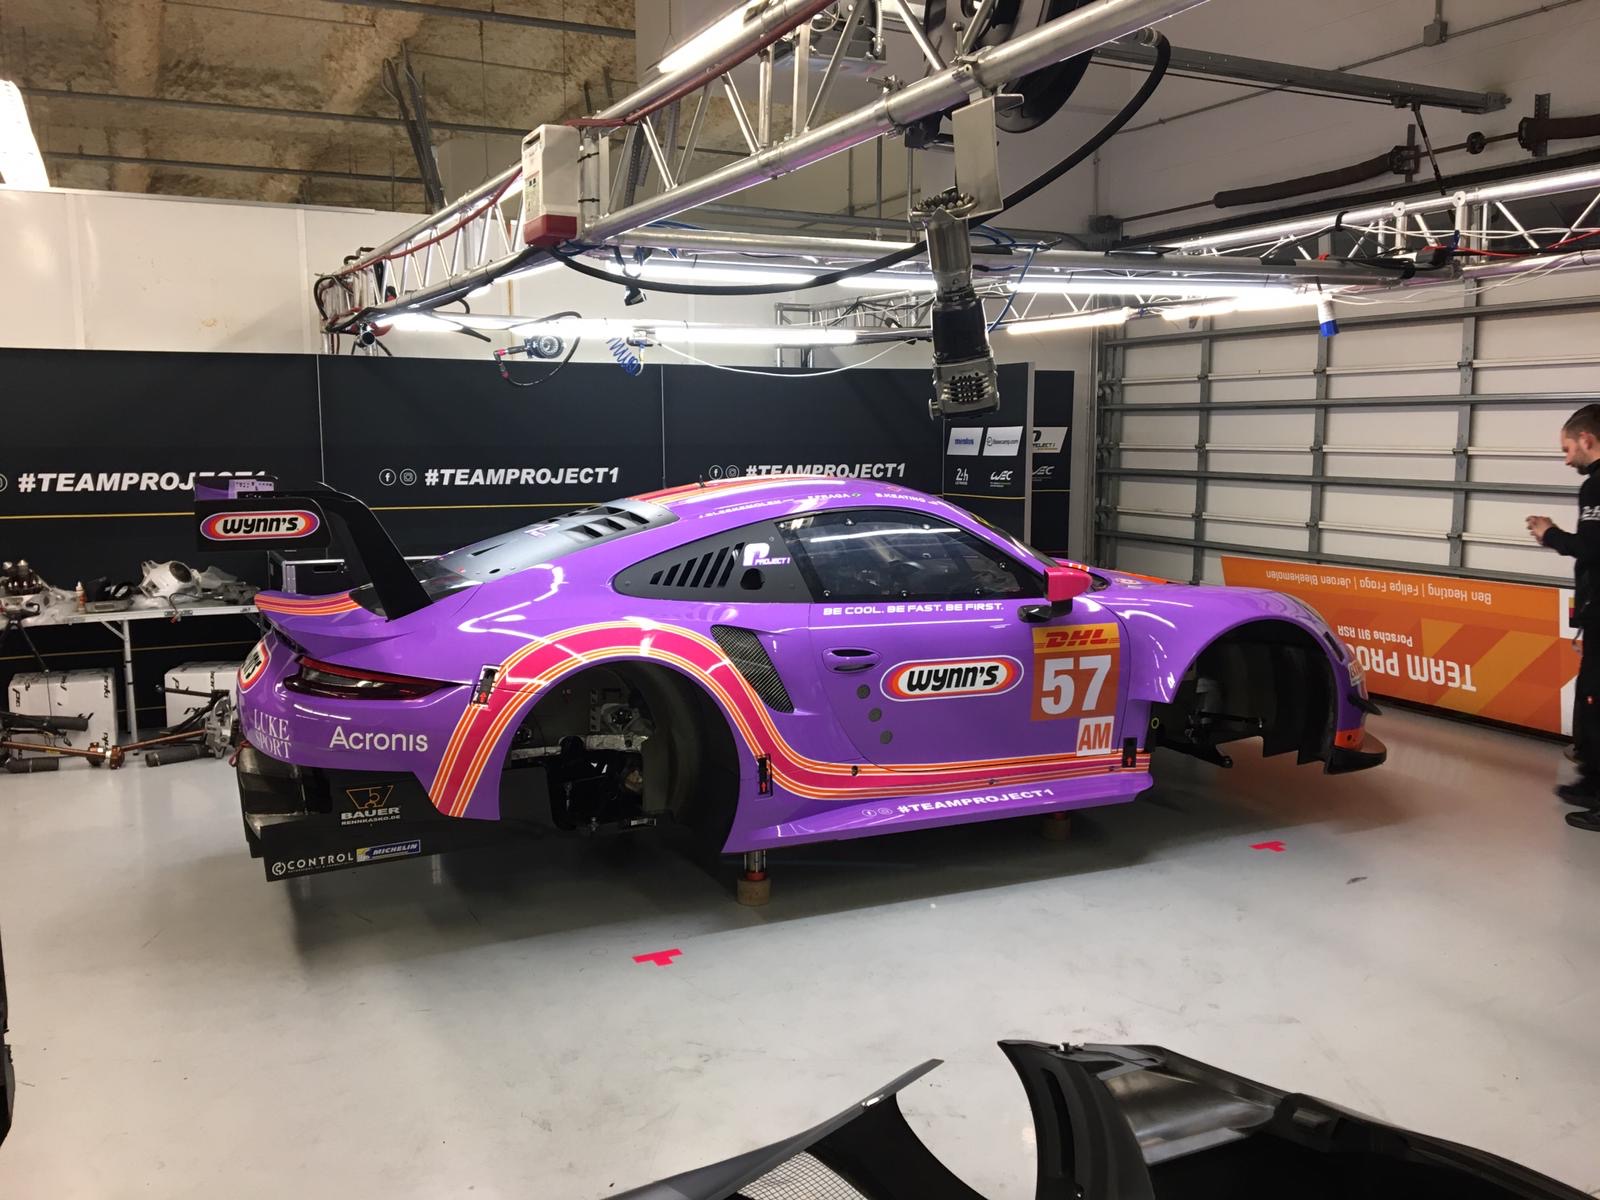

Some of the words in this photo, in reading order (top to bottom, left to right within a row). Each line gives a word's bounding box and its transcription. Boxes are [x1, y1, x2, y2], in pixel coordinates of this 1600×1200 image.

[18, 470, 265, 493] #TEAMPROJ
[425, 467, 619, 486] #TEAMPROJECT1
[1321, 576, 1352, 589] Jeroen
[1360, 577, 1387, 592] Fraga
[1390, 580, 1419, 596] Felipe
[1428, 583, 1468, 602] Keating
[1471, 591, 1492, 605] Ben
[823, 607, 842, 616] BE
[845, 606, 885, 615] COOL.
[887, 604, 905, 613] BE
[907, 603, 943, 612] FAST.
[945, 603, 963, 612] BE
[965, 602, 1004, 611] FIRST.
[1045, 629, 1110, 648] DHL
[1337, 625, 1356, 638] RSR
[1357, 628, 1371, 640] 911
[1373, 629, 1413, 647] Porsche
[1407, 653, 1477, 692] TEAM
[1041, 655, 1111, 715] 57
[253, 708, 290, 741] LUKE
[255, 733, 292, 759] SPORT
[329, 726, 428, 752] Acronis
[1078, 722, 1111, 752] AM
[896, 788, 1054, 814] #TEAMPROJECT1
[341, 807, 400, 820] BAUER
[372, 843, 418, 856] MICHELIN
[287, 853, 354, 870] CONTROL
